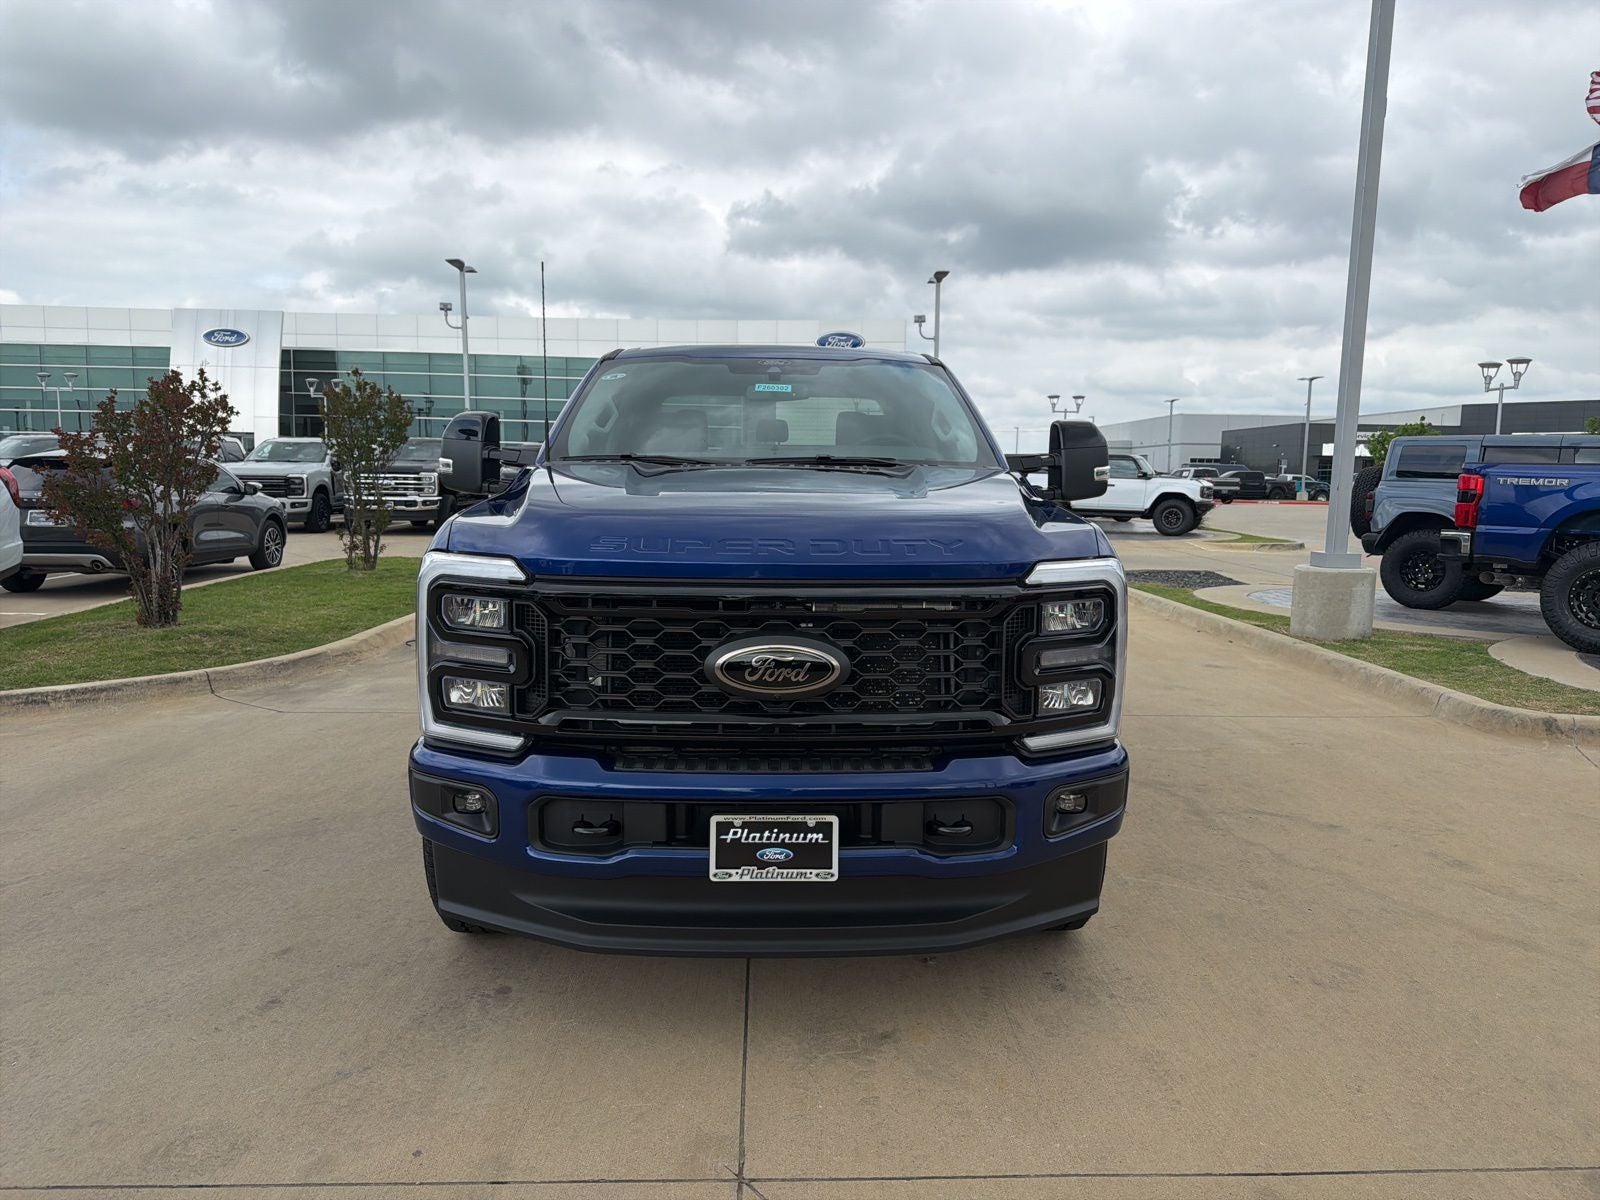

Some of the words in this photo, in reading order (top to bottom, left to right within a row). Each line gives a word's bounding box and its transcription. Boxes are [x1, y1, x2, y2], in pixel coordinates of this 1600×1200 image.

[211, 331, 238, 342] Ford
[825, 335, 854, 348] Ford
[1496, 477, 1570, 486] TREMOR
[589, 535, 796, 556] SUPER
[809, 537, 964, 556] DUTY
[744, 655, 812, 682] Ford
[719, 828, 830, 843] Platinum
[763, 849, 786, 860] Ford
[739, 867, 814, 880] Platinum
